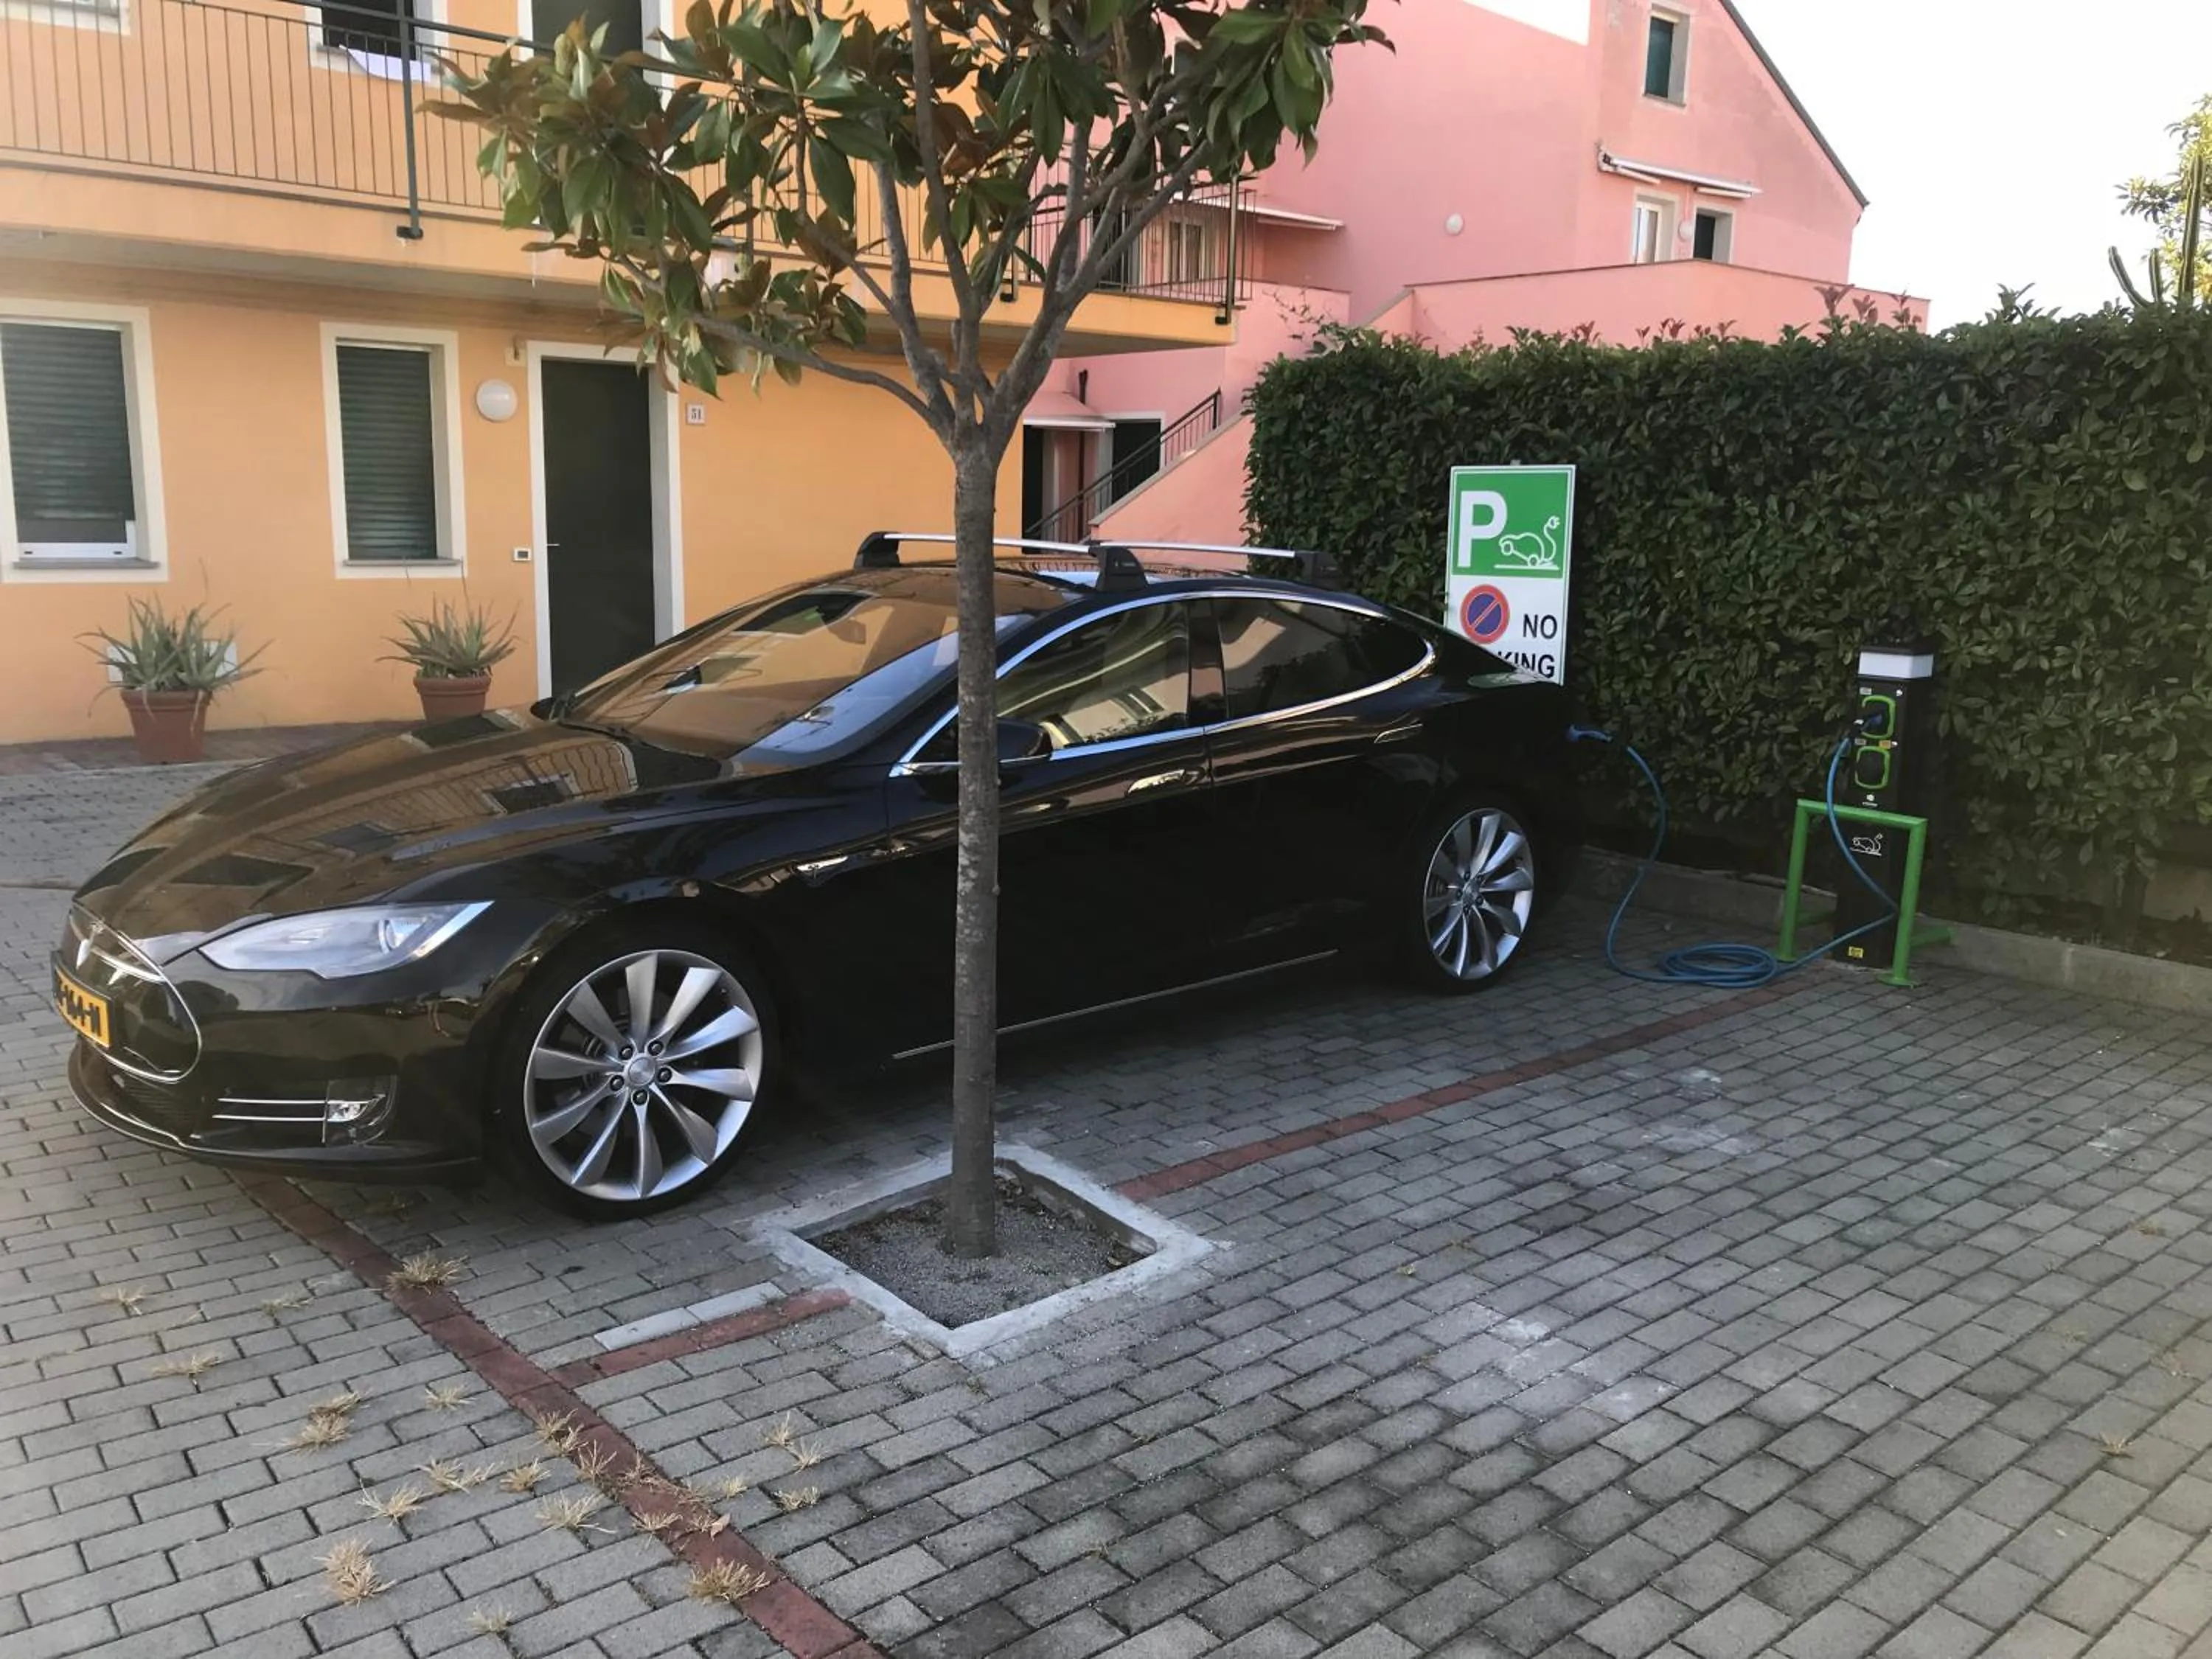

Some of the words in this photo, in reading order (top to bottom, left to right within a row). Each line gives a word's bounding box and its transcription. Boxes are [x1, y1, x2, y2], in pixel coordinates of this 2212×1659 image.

[1457, 490, 1508, 568] P
[1523, 613, 1557, 639] NO
[1498, 651, 1555, 678] ING
